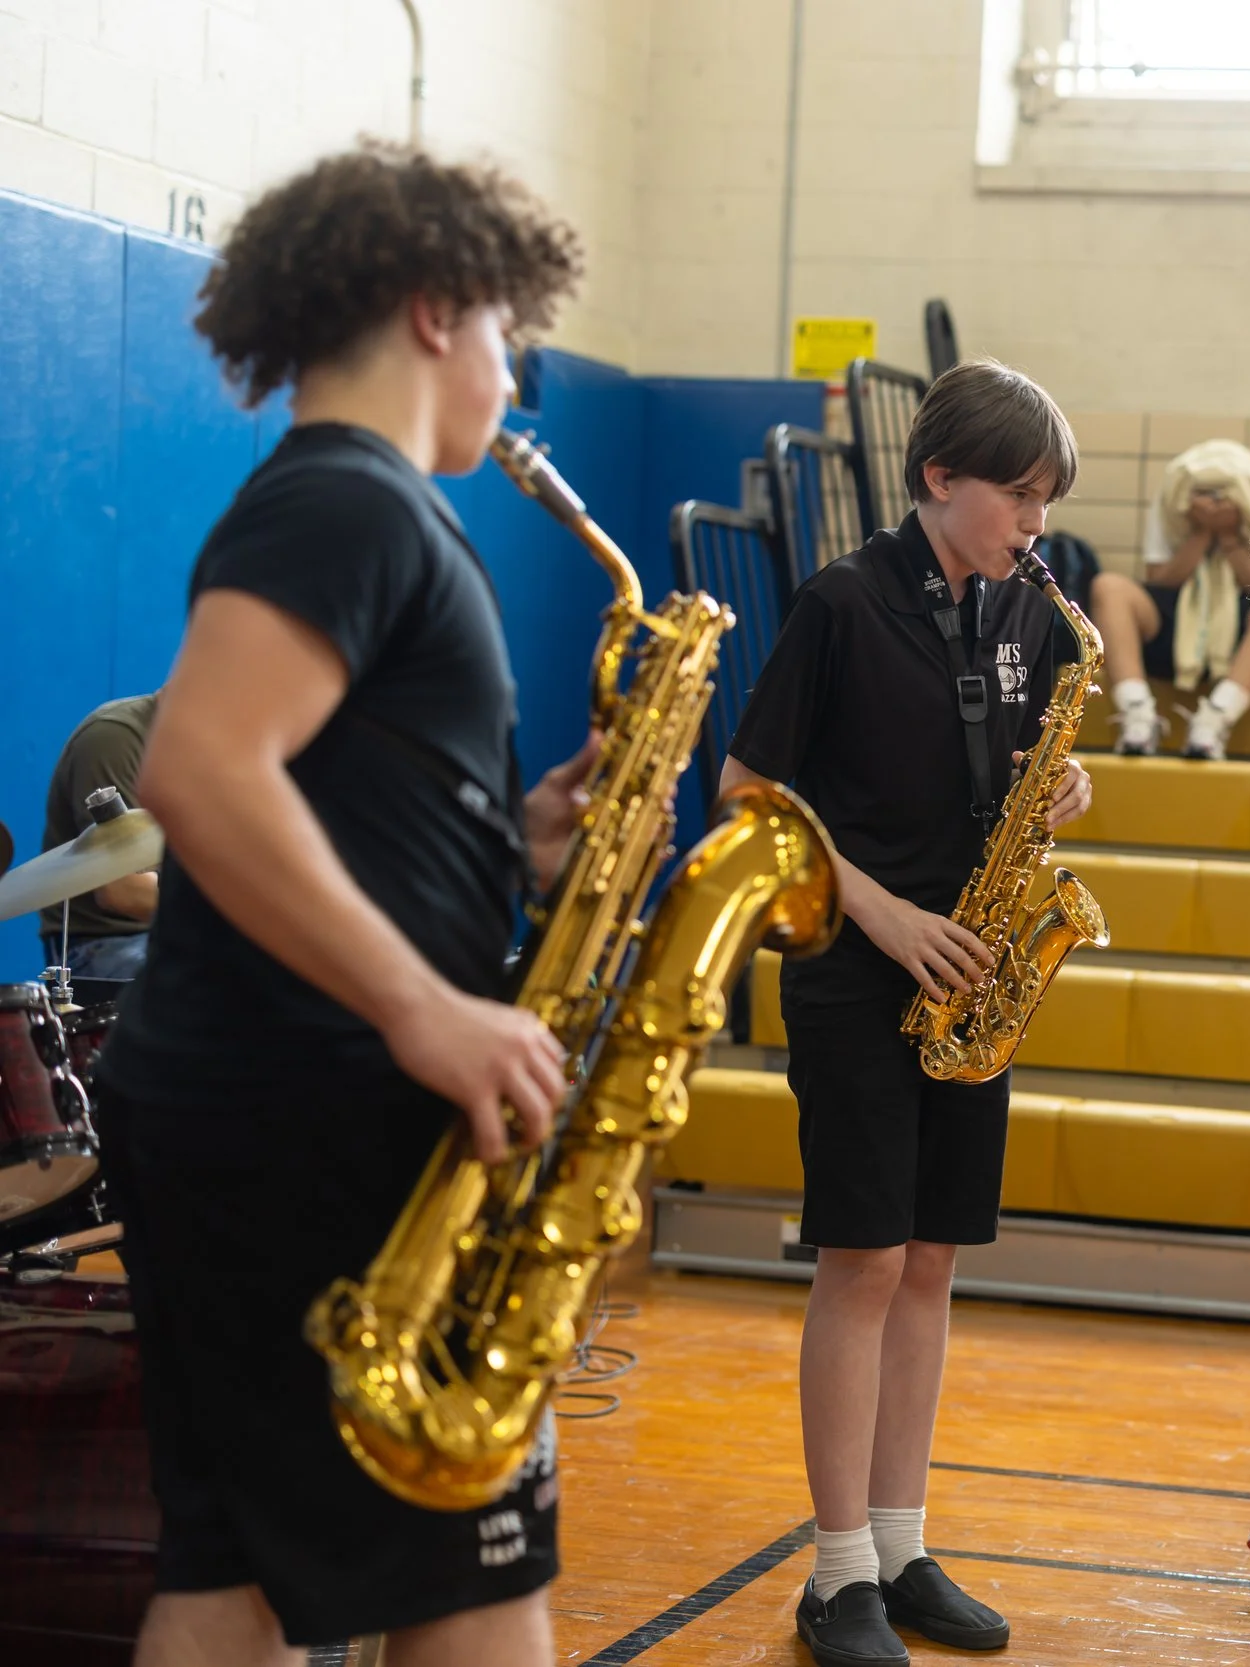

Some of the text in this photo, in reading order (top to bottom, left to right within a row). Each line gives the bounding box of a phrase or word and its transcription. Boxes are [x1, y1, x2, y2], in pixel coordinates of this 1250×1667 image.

[169, 188, 206, 241] 16
[996, 643, 1020, 663] MS
[1016, 666, 1028, 688] 50
[1001, 693, 1017, 703] AZZ
